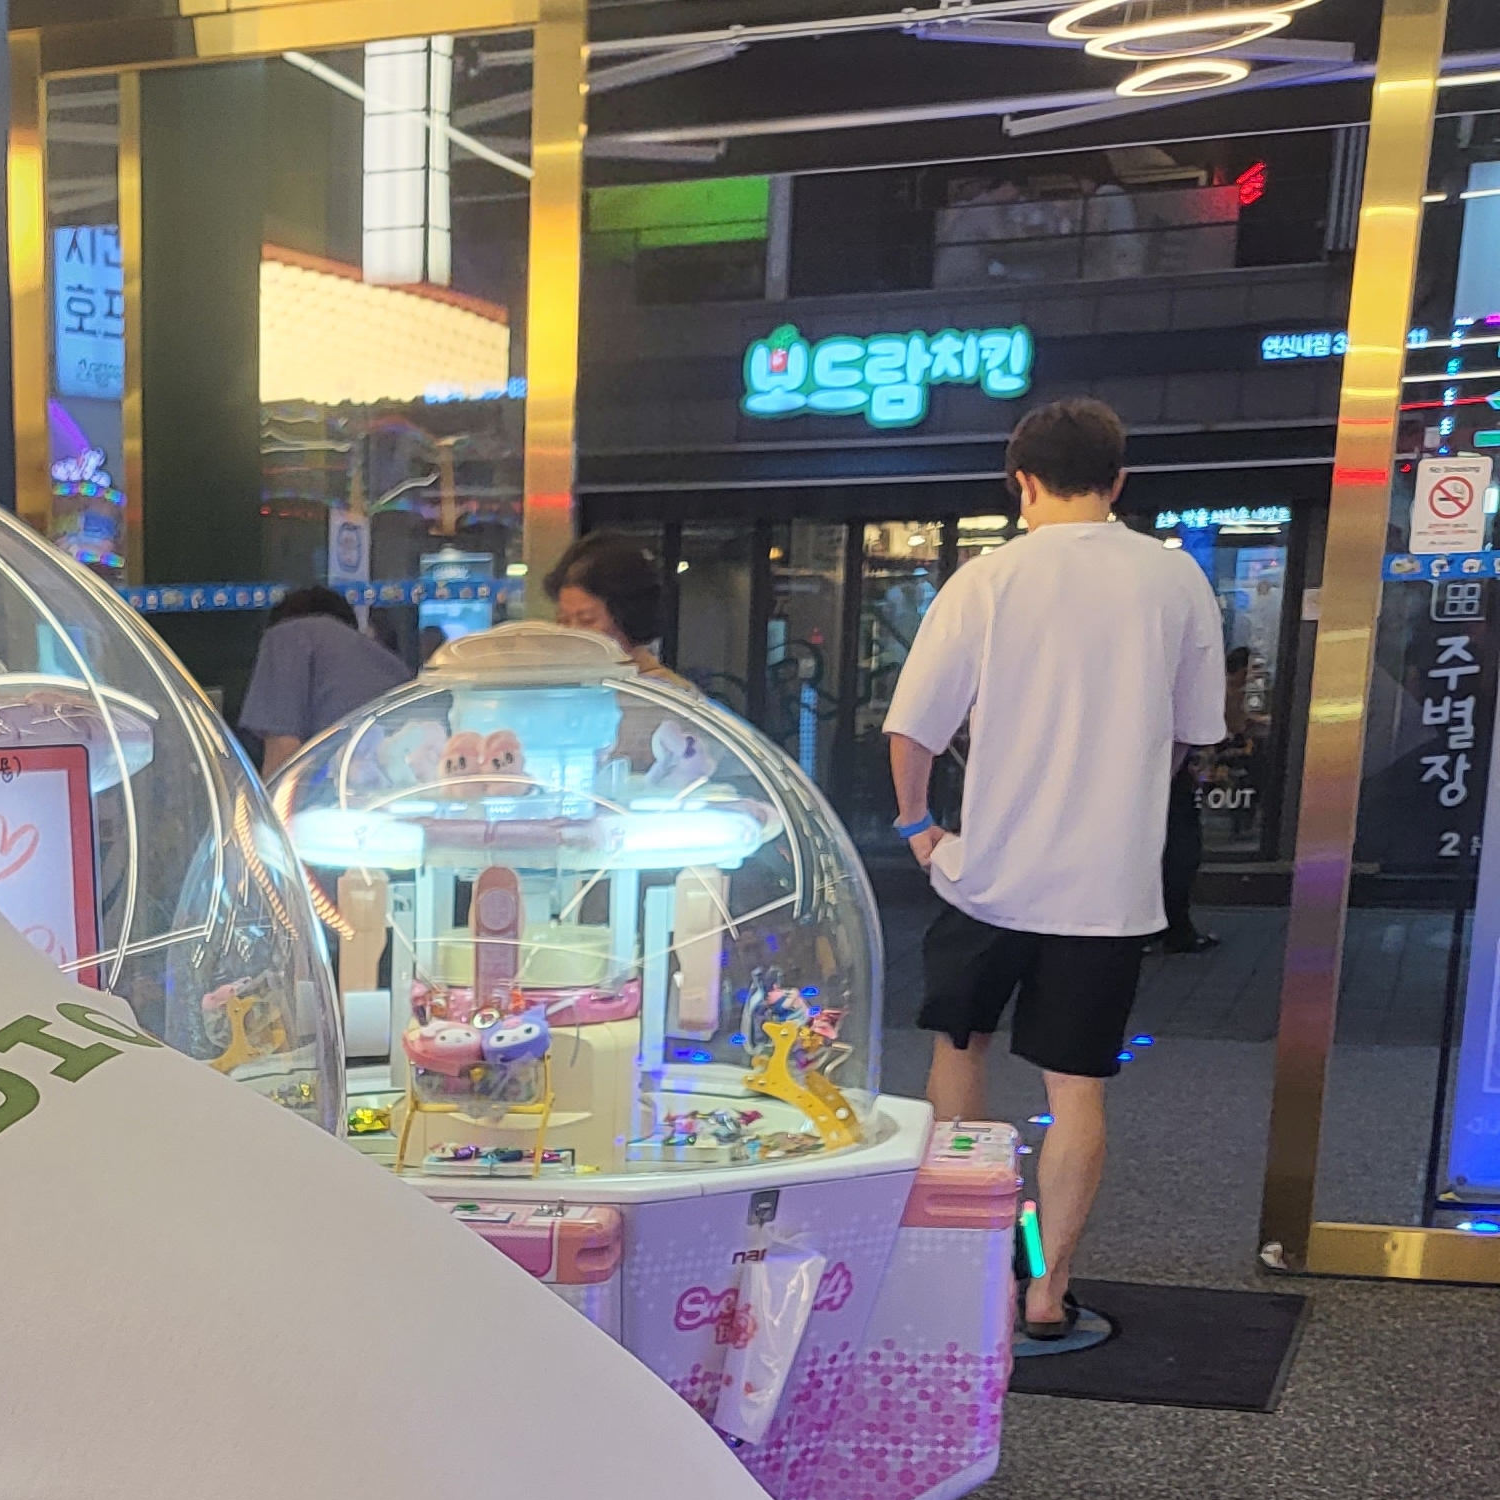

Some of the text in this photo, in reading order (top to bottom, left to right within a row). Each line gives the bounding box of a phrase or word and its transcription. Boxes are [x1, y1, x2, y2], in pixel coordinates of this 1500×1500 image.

[745, 329, 1031, 422] 보드람치킨
[1262, 332, 1332, 359] 연신내점
[1420, 635, 1481, 808] 주별장
[1208, 787, 1256, 809] OUT
